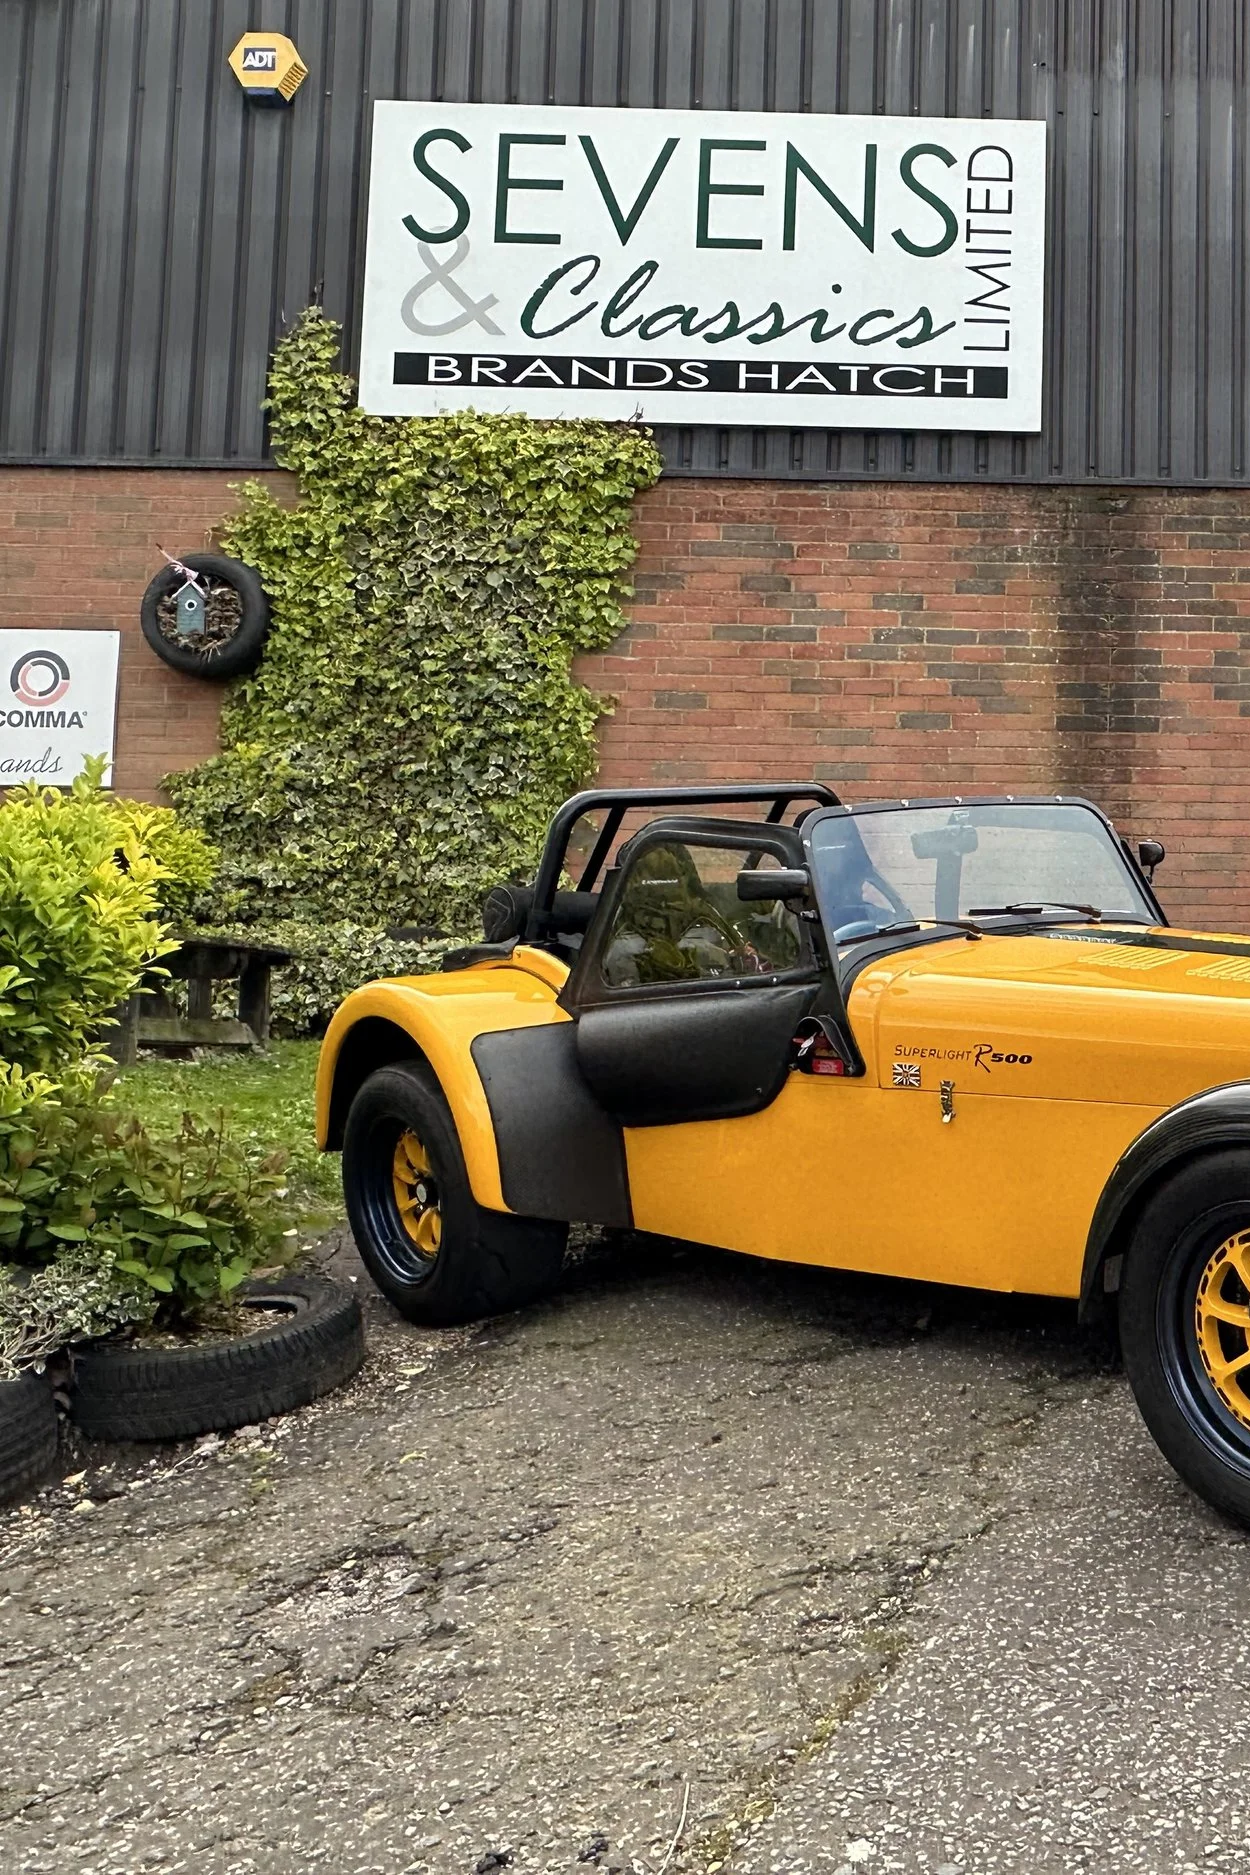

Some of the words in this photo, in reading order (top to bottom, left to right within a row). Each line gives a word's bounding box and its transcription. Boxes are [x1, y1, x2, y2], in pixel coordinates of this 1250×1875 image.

[242, 51, 277, 68] ADT
[401, 128, 959, 258] SEVENS
[963, 144, 1014, 352] LIMITED
[400, 225, 506, 337] &
[519, 254, 956, 349] Classics
[426, 355, 710, 390] BRANDS
[738, 362, 976, 395] HATCH
